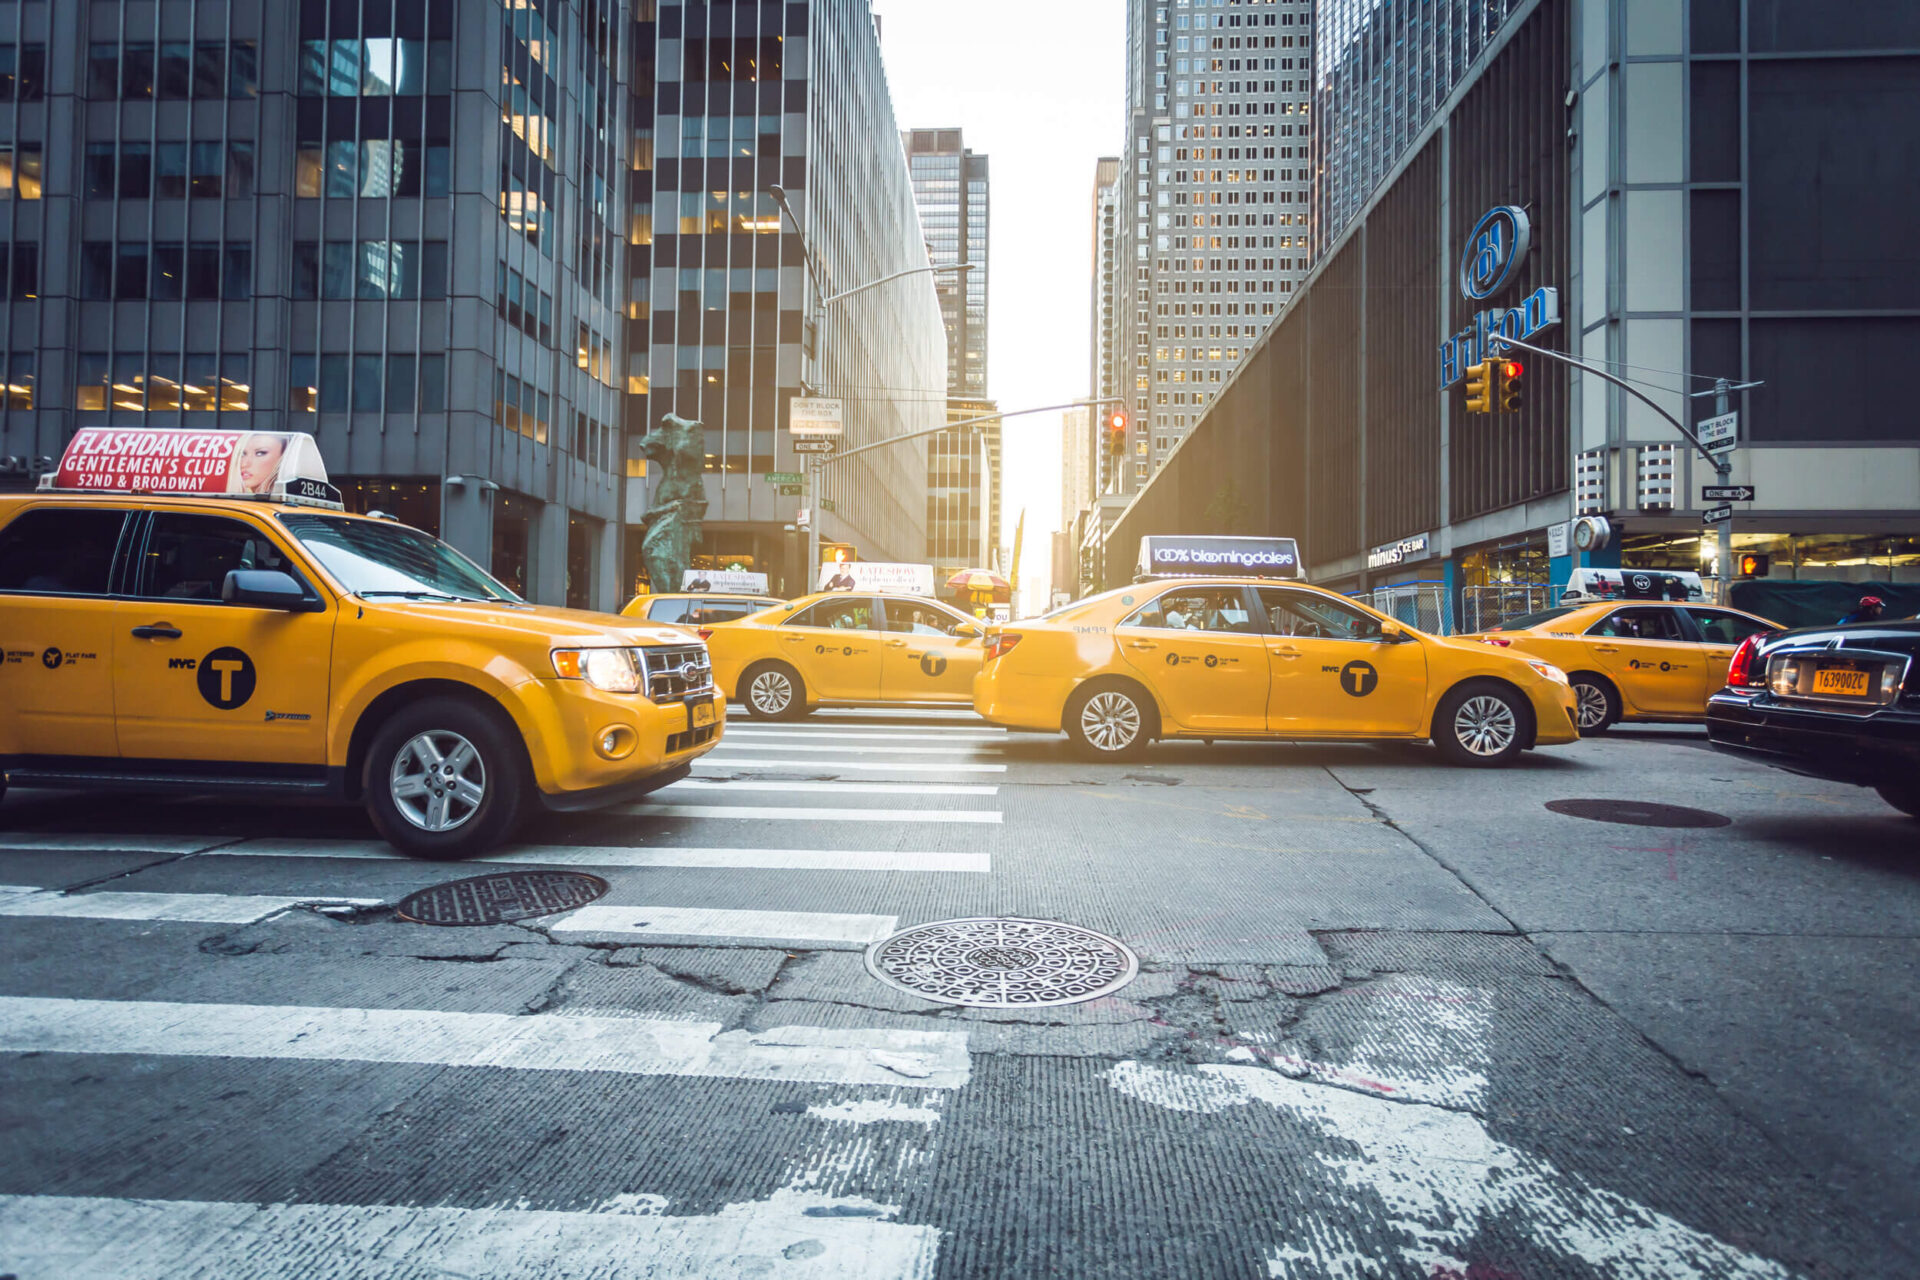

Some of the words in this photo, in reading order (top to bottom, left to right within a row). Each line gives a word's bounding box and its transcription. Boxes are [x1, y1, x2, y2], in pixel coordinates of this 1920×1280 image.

[1439, 286, 1550, 390] Hilton
[1716, 417, 1734, 428] BLOCK
[1705, 429, 1716, 438] THE
[1716, 427, 1728, 437] BOX
[72, 431, 238, 459] FLASHDANCERS
[65, 455, 178, 476] GENTLEMEN'S
[184, 459, 226, 476] CLUB
[77, 474, 112, 488] 52ND
[117, 475, 127, 488] &
[132, 476, 206, 491] BROADWAY
[300, 480, 327, 498] 2B44
[1402, 542, 1412, 553] ICE
[1412, 538, 1424, 551] BAR
[1154, 548, 1189, 562] 100%
[1191, 549, 1293, 566] bloomingdale's
[1321, 665, 1340, 673] NYC
[168, 658, 197, 669] NYC
[211, 659, 243, 702] T
